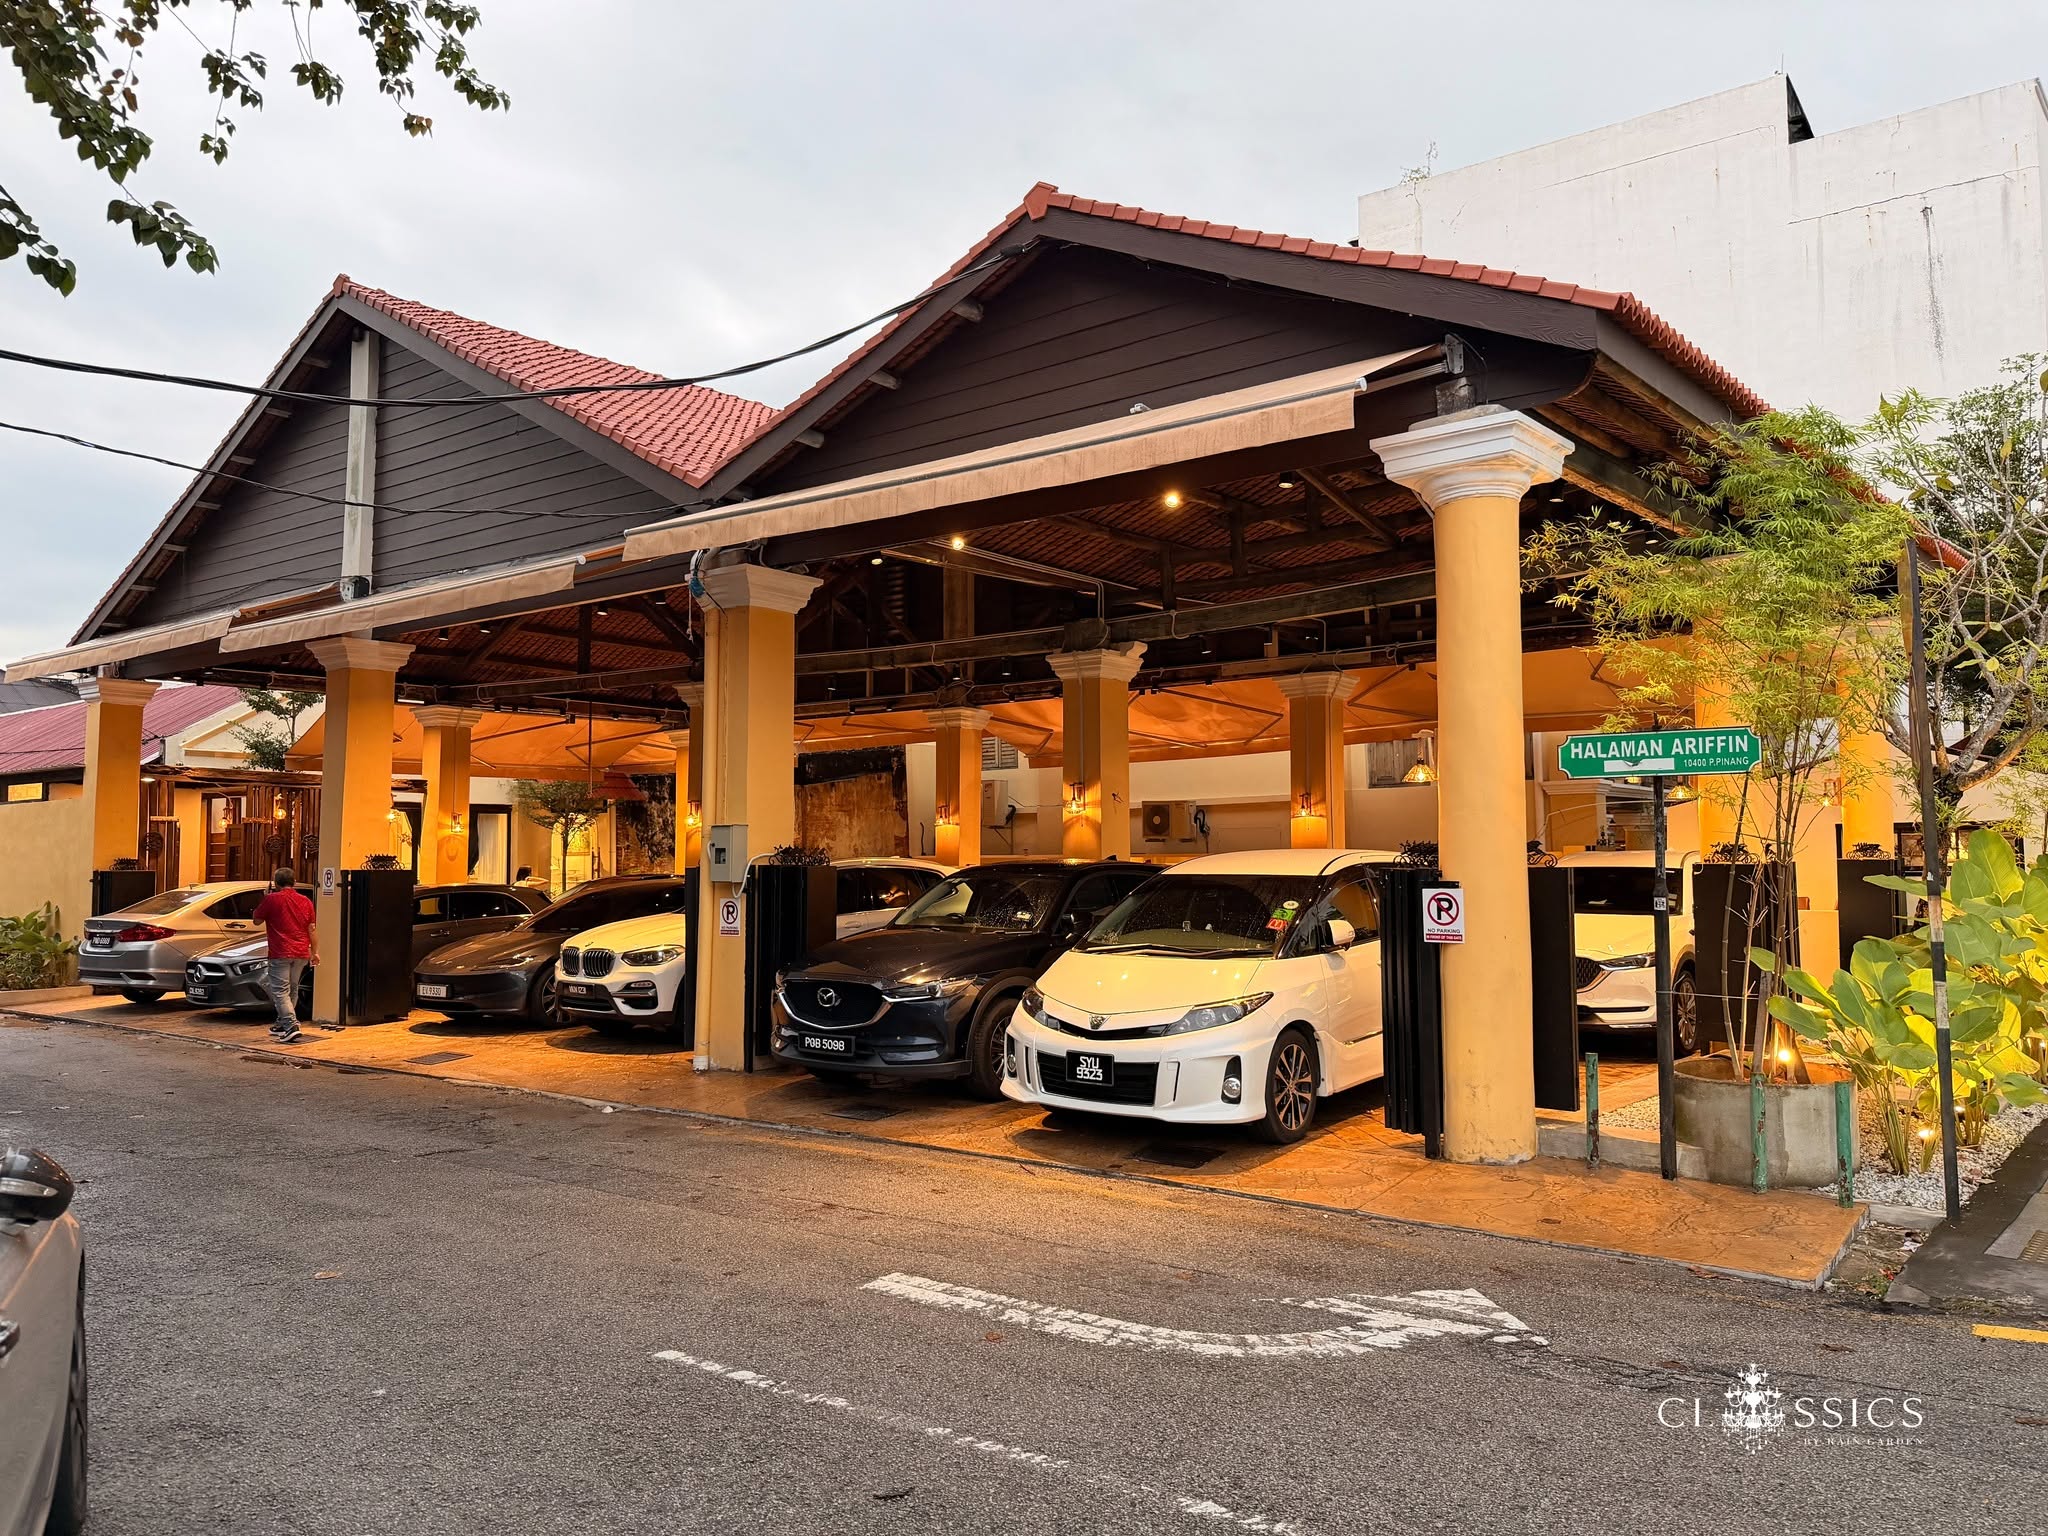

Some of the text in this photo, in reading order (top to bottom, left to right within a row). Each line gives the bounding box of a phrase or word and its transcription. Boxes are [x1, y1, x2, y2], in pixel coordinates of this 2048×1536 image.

[1570, 735, 1748, 759] HALAMAN ARIFFIN
[1684, 756, 1749, 768] 10400 P.PINANG
[422, 986, 429, 995] EV
[822, 1038, 845, 1051] 5098
[1079, 1056, 1100, 1069] SYU
[1076, 1066, 1103, 1081] 9323
